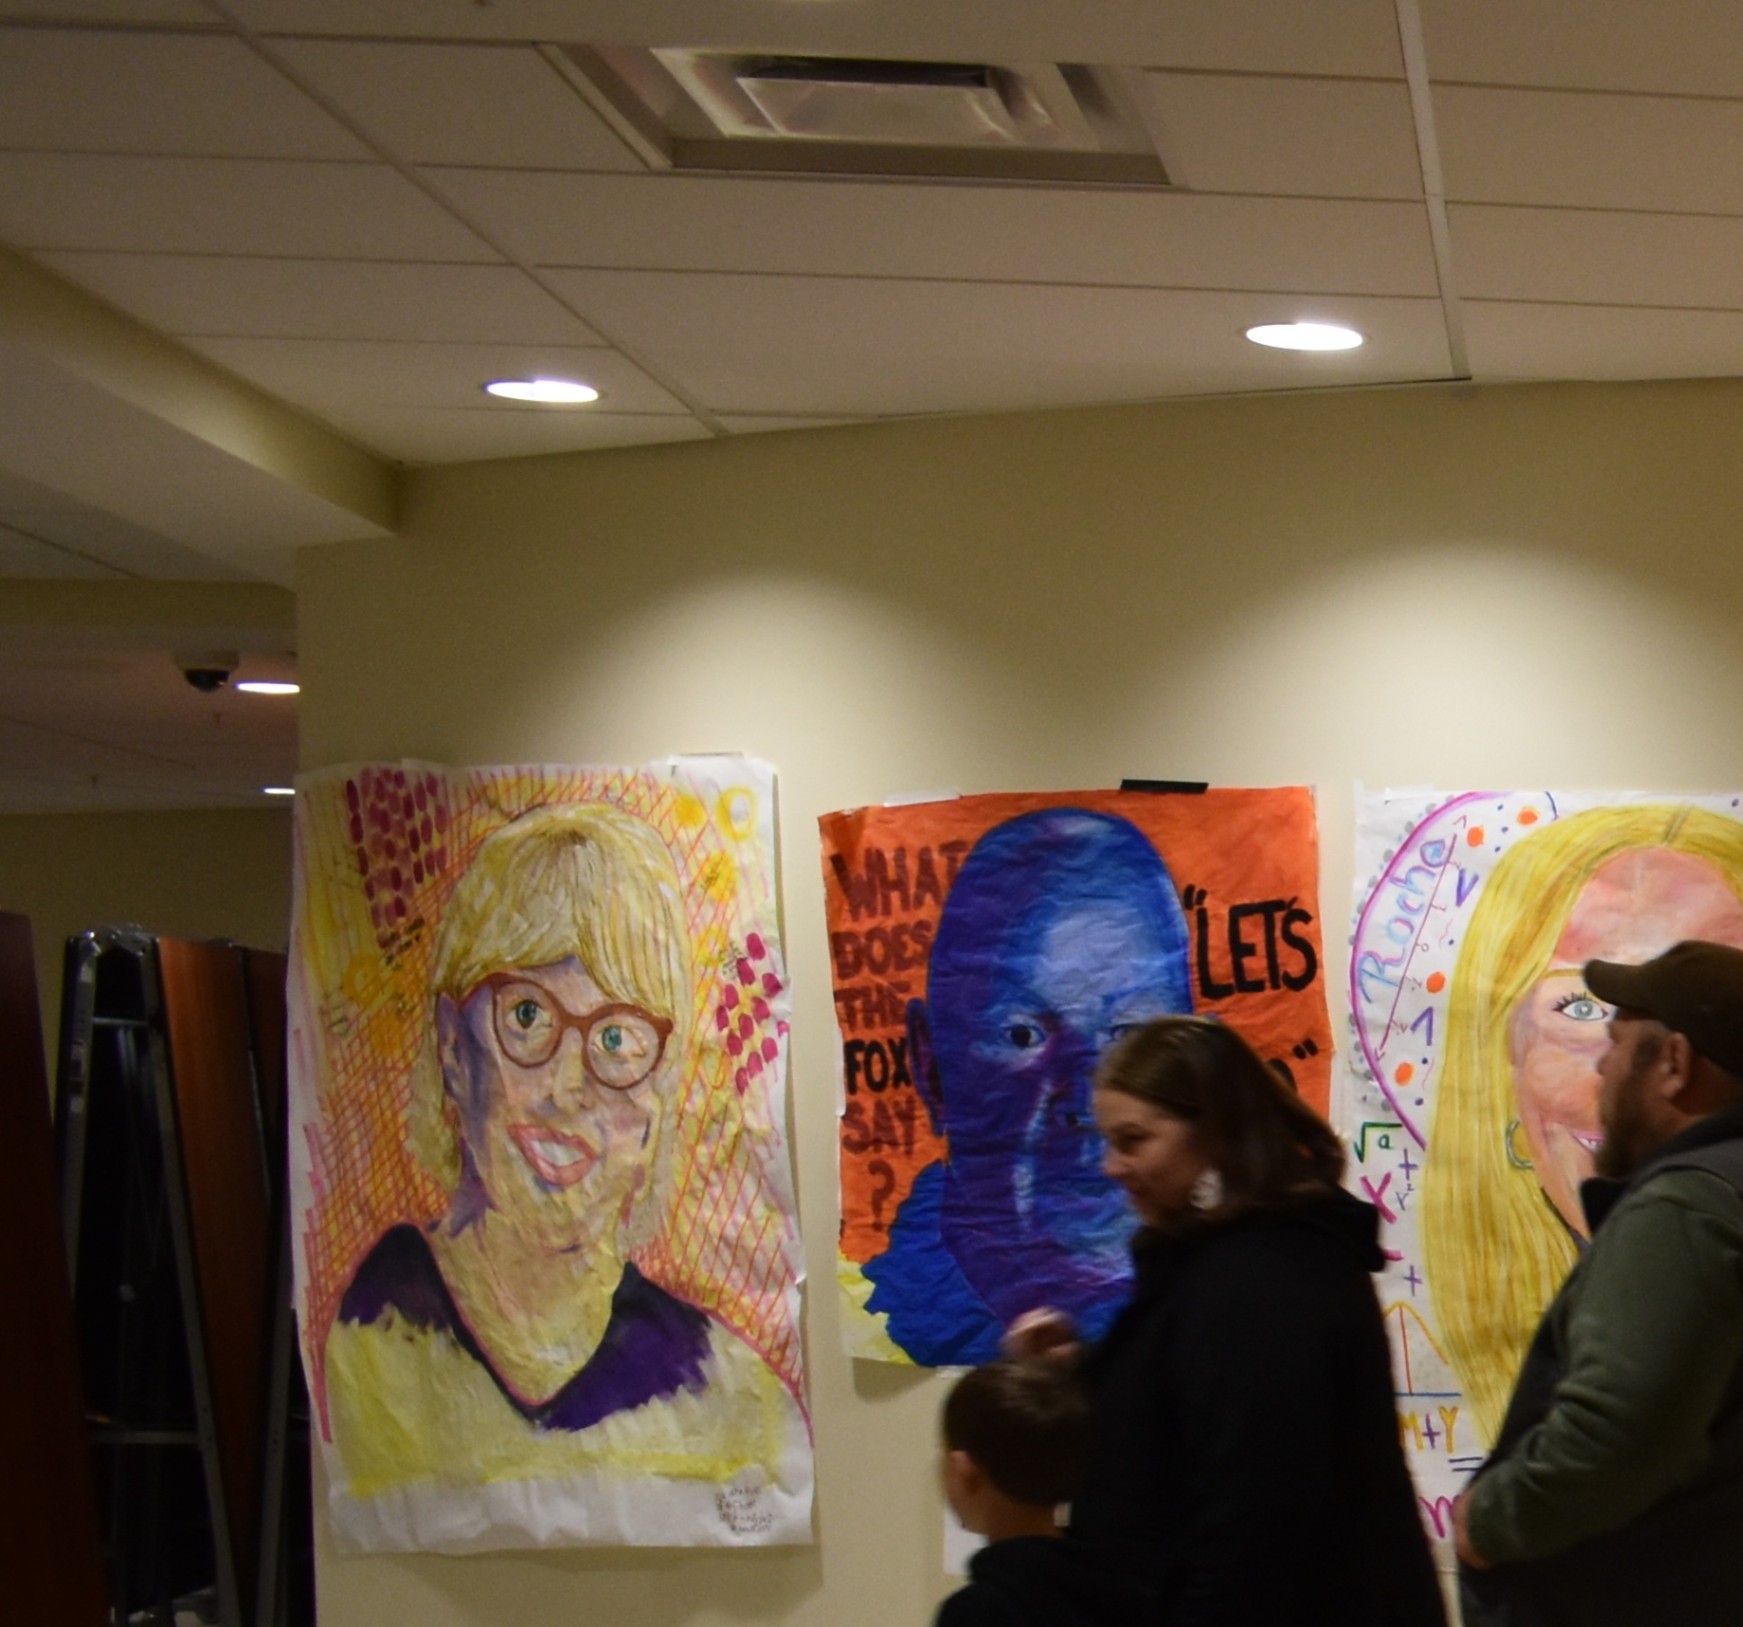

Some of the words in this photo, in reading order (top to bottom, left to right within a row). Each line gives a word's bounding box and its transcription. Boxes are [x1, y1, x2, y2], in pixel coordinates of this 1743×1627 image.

[831, 840, 970, 922] WHAT
[832, 920, 932, 980] DOES
[845, 1038, 911, 1094] FOX
[842, 1095, 915, 1157] SAY
